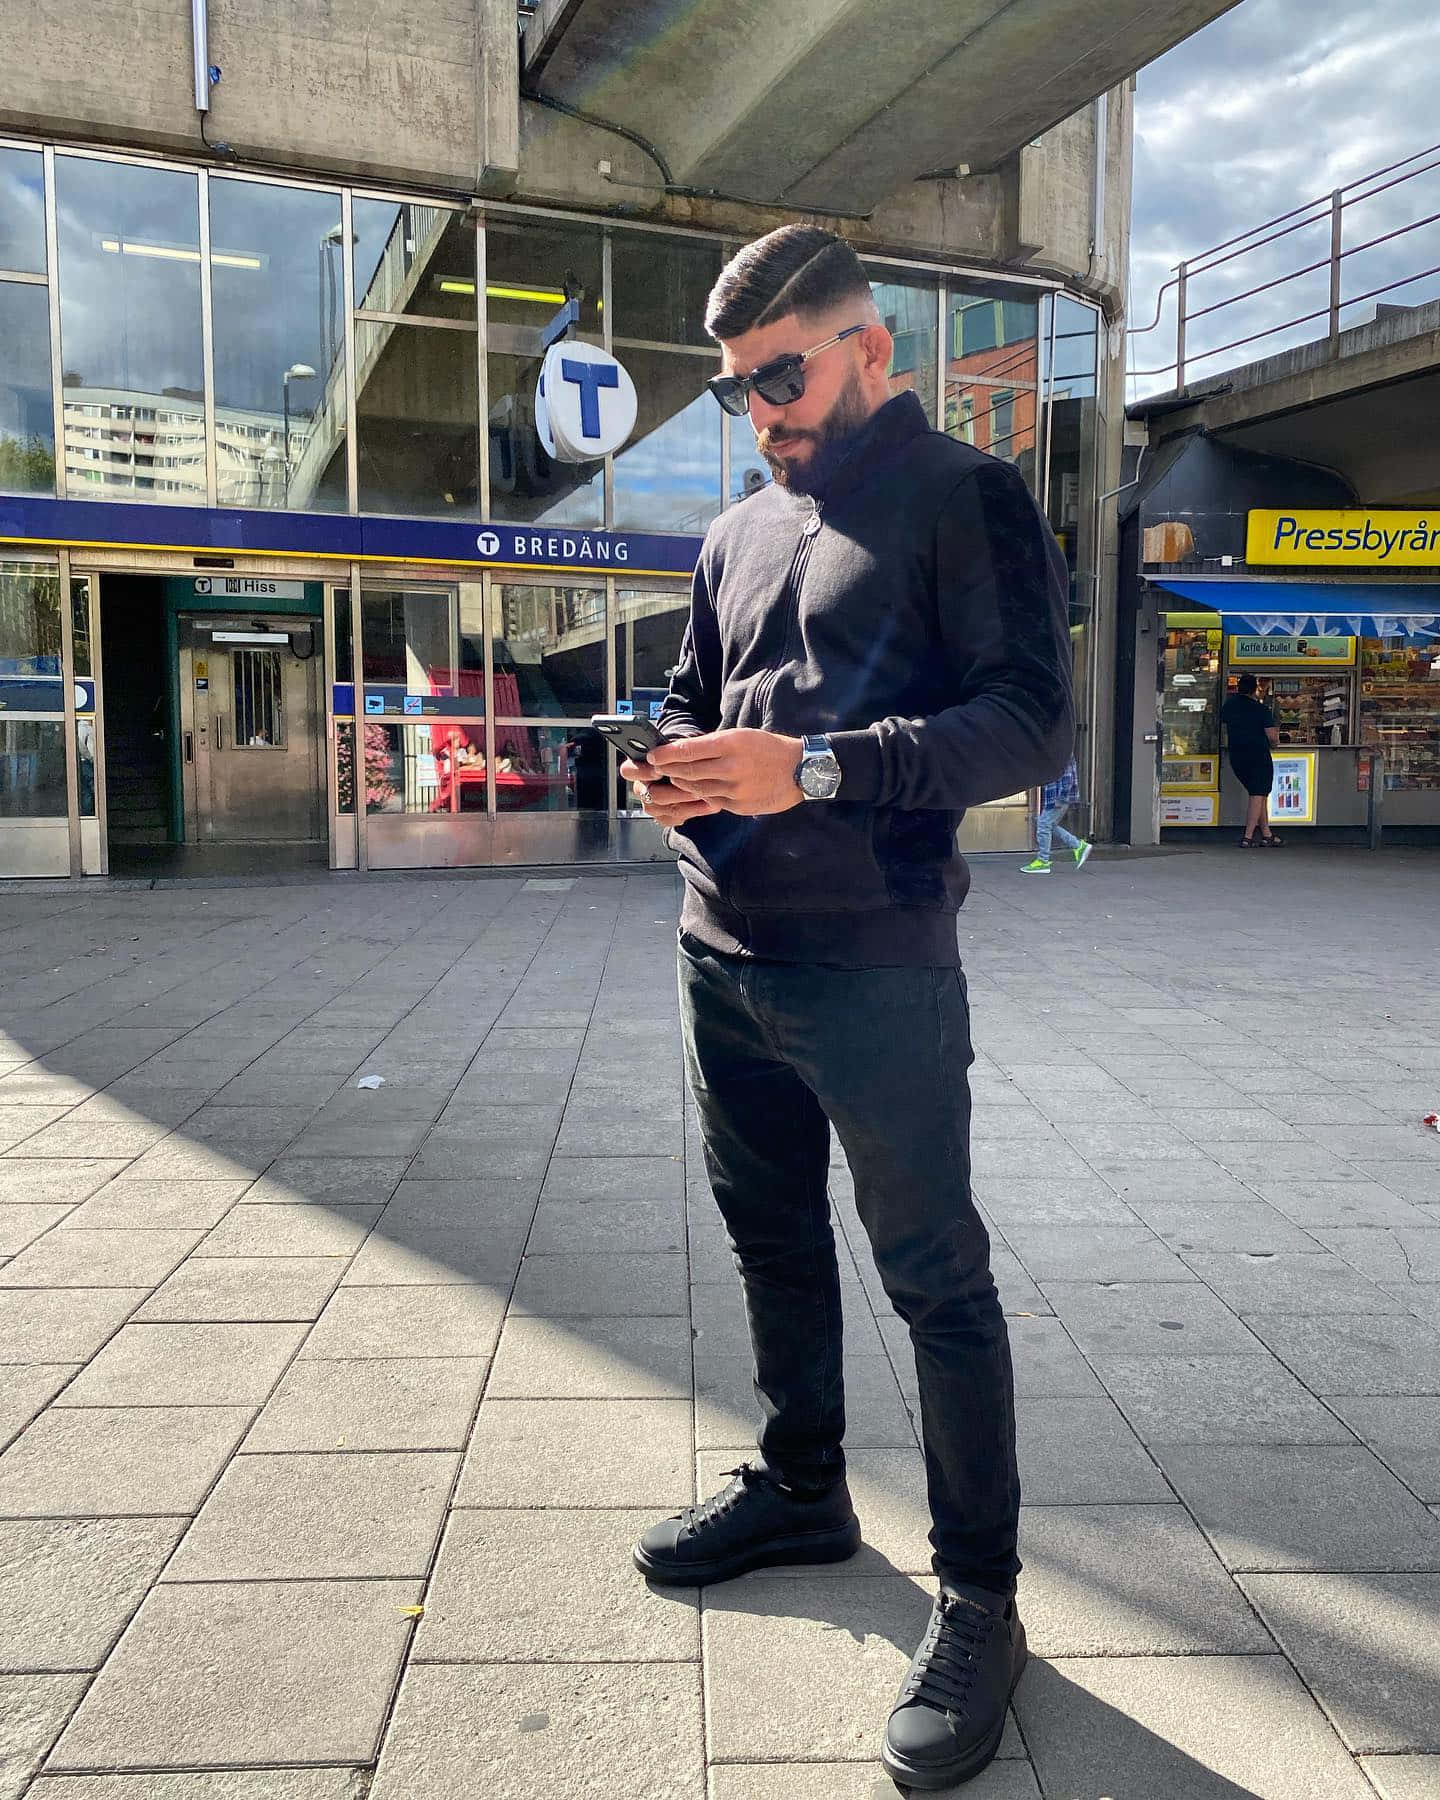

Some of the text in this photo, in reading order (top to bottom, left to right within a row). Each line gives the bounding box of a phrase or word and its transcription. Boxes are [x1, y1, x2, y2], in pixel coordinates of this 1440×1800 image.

[561, 358, 619, 439] T
[514, 535, 629, 561] BREDÄNG
[245, 581, 276, 593] Hiss
[1240, 642, 1261, 653] Kaffe
[1262, 642, 1269, 652] &
